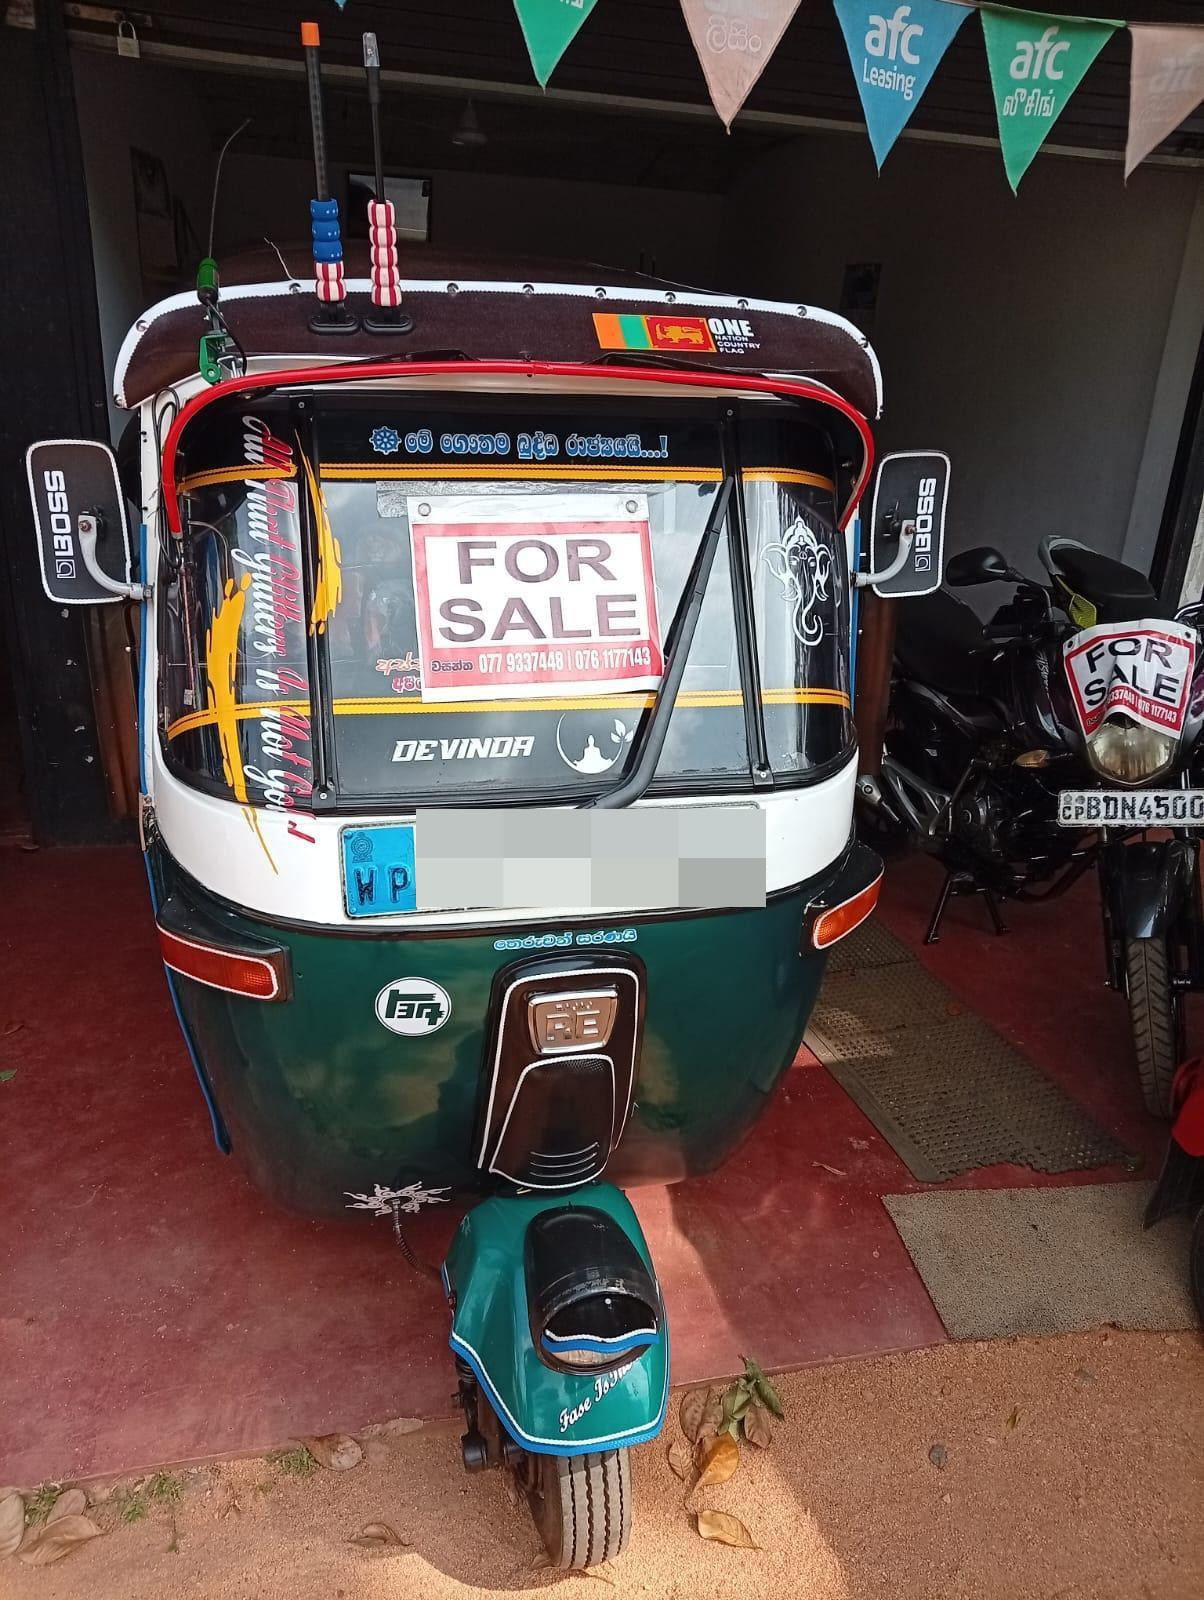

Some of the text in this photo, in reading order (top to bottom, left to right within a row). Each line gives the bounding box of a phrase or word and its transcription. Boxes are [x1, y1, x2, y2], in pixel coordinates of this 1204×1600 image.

[864, 6, 923, 65] afc
[1009, 25, 1071, 81] afc
[863, 58, 916, 100] Leasing
[708, 317, 754, 337] ONE
[717, 341, 761, 349] COUNTRY
[405, 428, 434, 454] මේ
[44, 471, 74, 557] BOSS
[244, 479, 297, 552] That
[915, 478, 937, 553] BOSS
[457, 539, 617, 584] FOR
[231, 548, 303, 657] Glitters
[439, 594, 641, 643] SALE
[479, 653, 502, 673] 077
[507, 651, 562, 673] 9337448
[575, 649, 599, 669] 076
[603, 647, 651, 668] 1177143
[1085, 638, 1174, 673] FOR
[255, 666, 309, 696] Is
[1084, 664, 1180, 707] SALE
[1151, 703, 1178, 724] 1177143
[260, 705, 312, 767] Not
[391, 736, 535, 763] DEVINDA
[1062, 805, 1084, 820] CP
